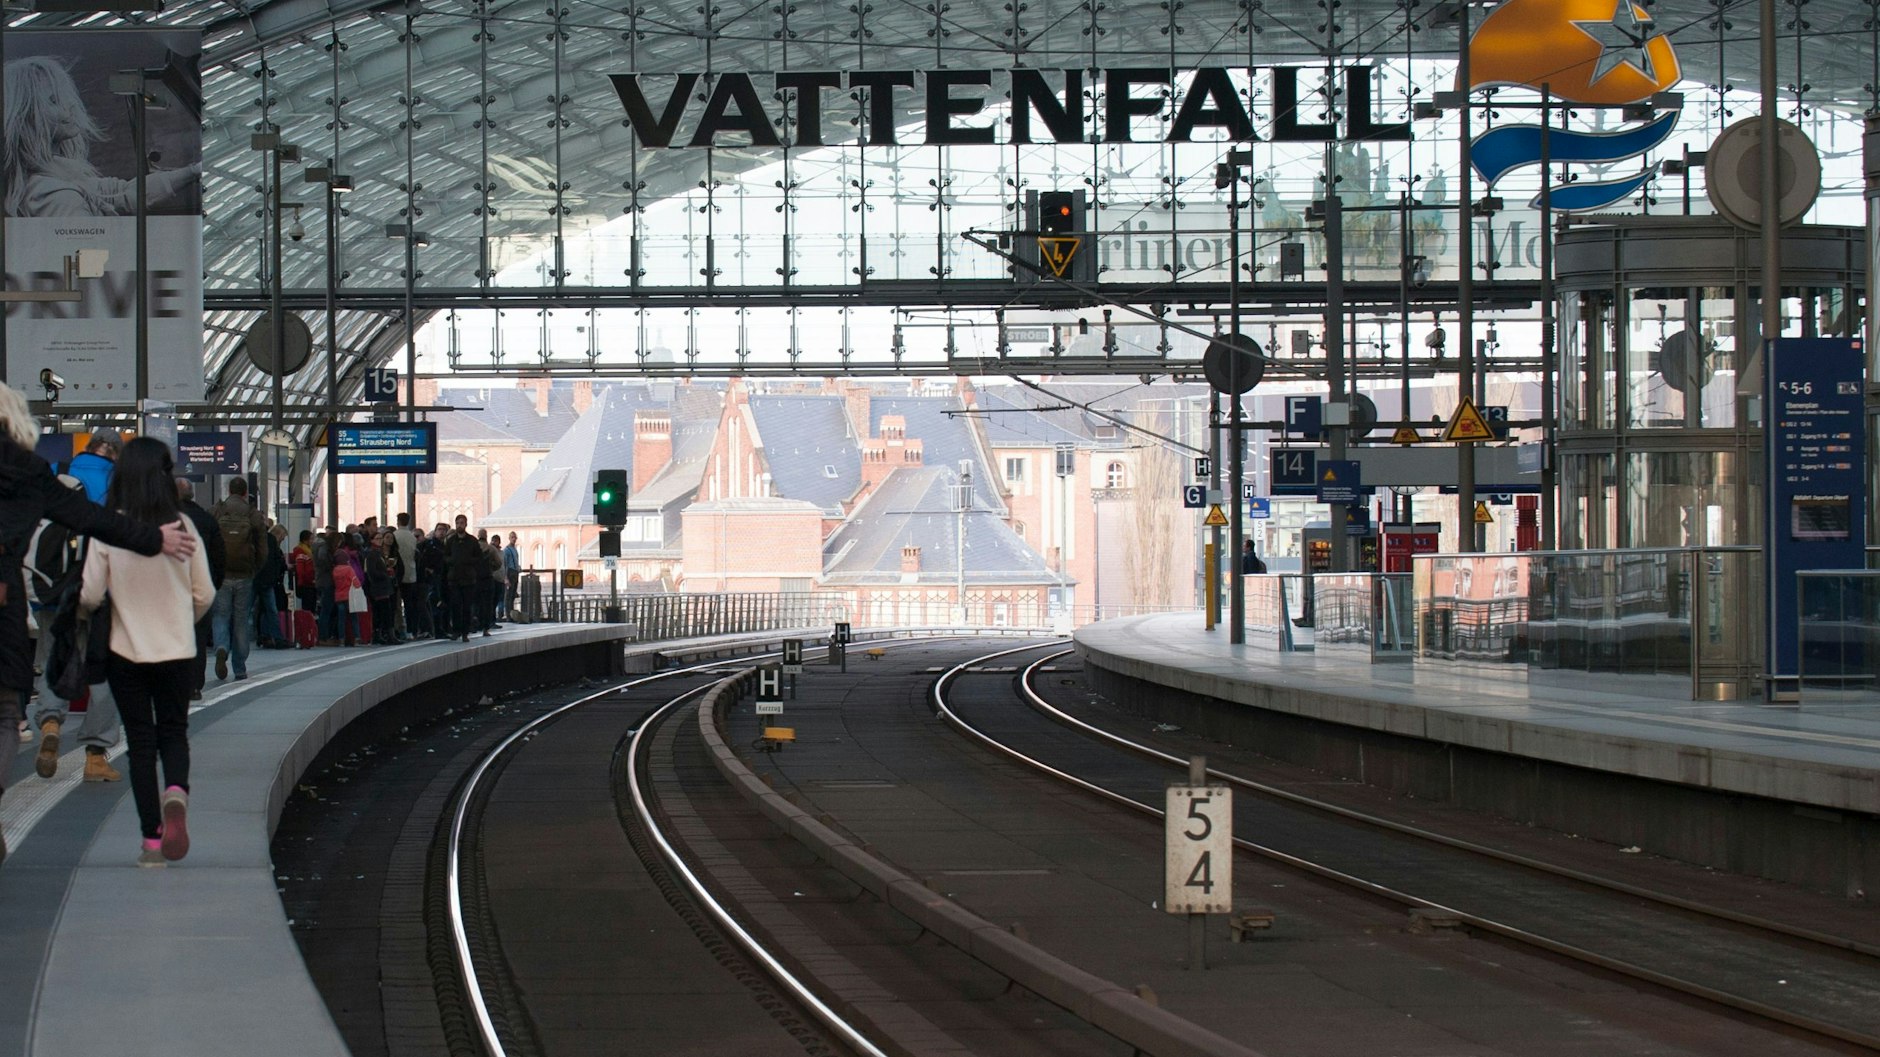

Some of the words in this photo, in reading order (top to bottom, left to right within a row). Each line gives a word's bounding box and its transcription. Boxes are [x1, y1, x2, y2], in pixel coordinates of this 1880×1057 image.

[608, 65, 1412, 148] VATTENFALL
[54, 228, 106, 236] VOLKSWAGEN
[369, 370, 397, 394] 15
[1791, 382, 1812, 395] 5-6
[1290, 398, 1307, 424] F
[360, 438, 395, 447] Strausberg
[397, 438, 412, 446] Nord
[1199, 460, 1208, 474] H
[1277, 452, 1304, 476] 14
[1186, 487, 1200, 504] G
[1245, 487, 1253, 497] H
[837, 625, 848, 640] H
[785, 642, 799, 661] H
[760, 669, 779, 696] H
[1184, 798, 1212, 841] 5
[1184, 851, 1214, 894] 4
